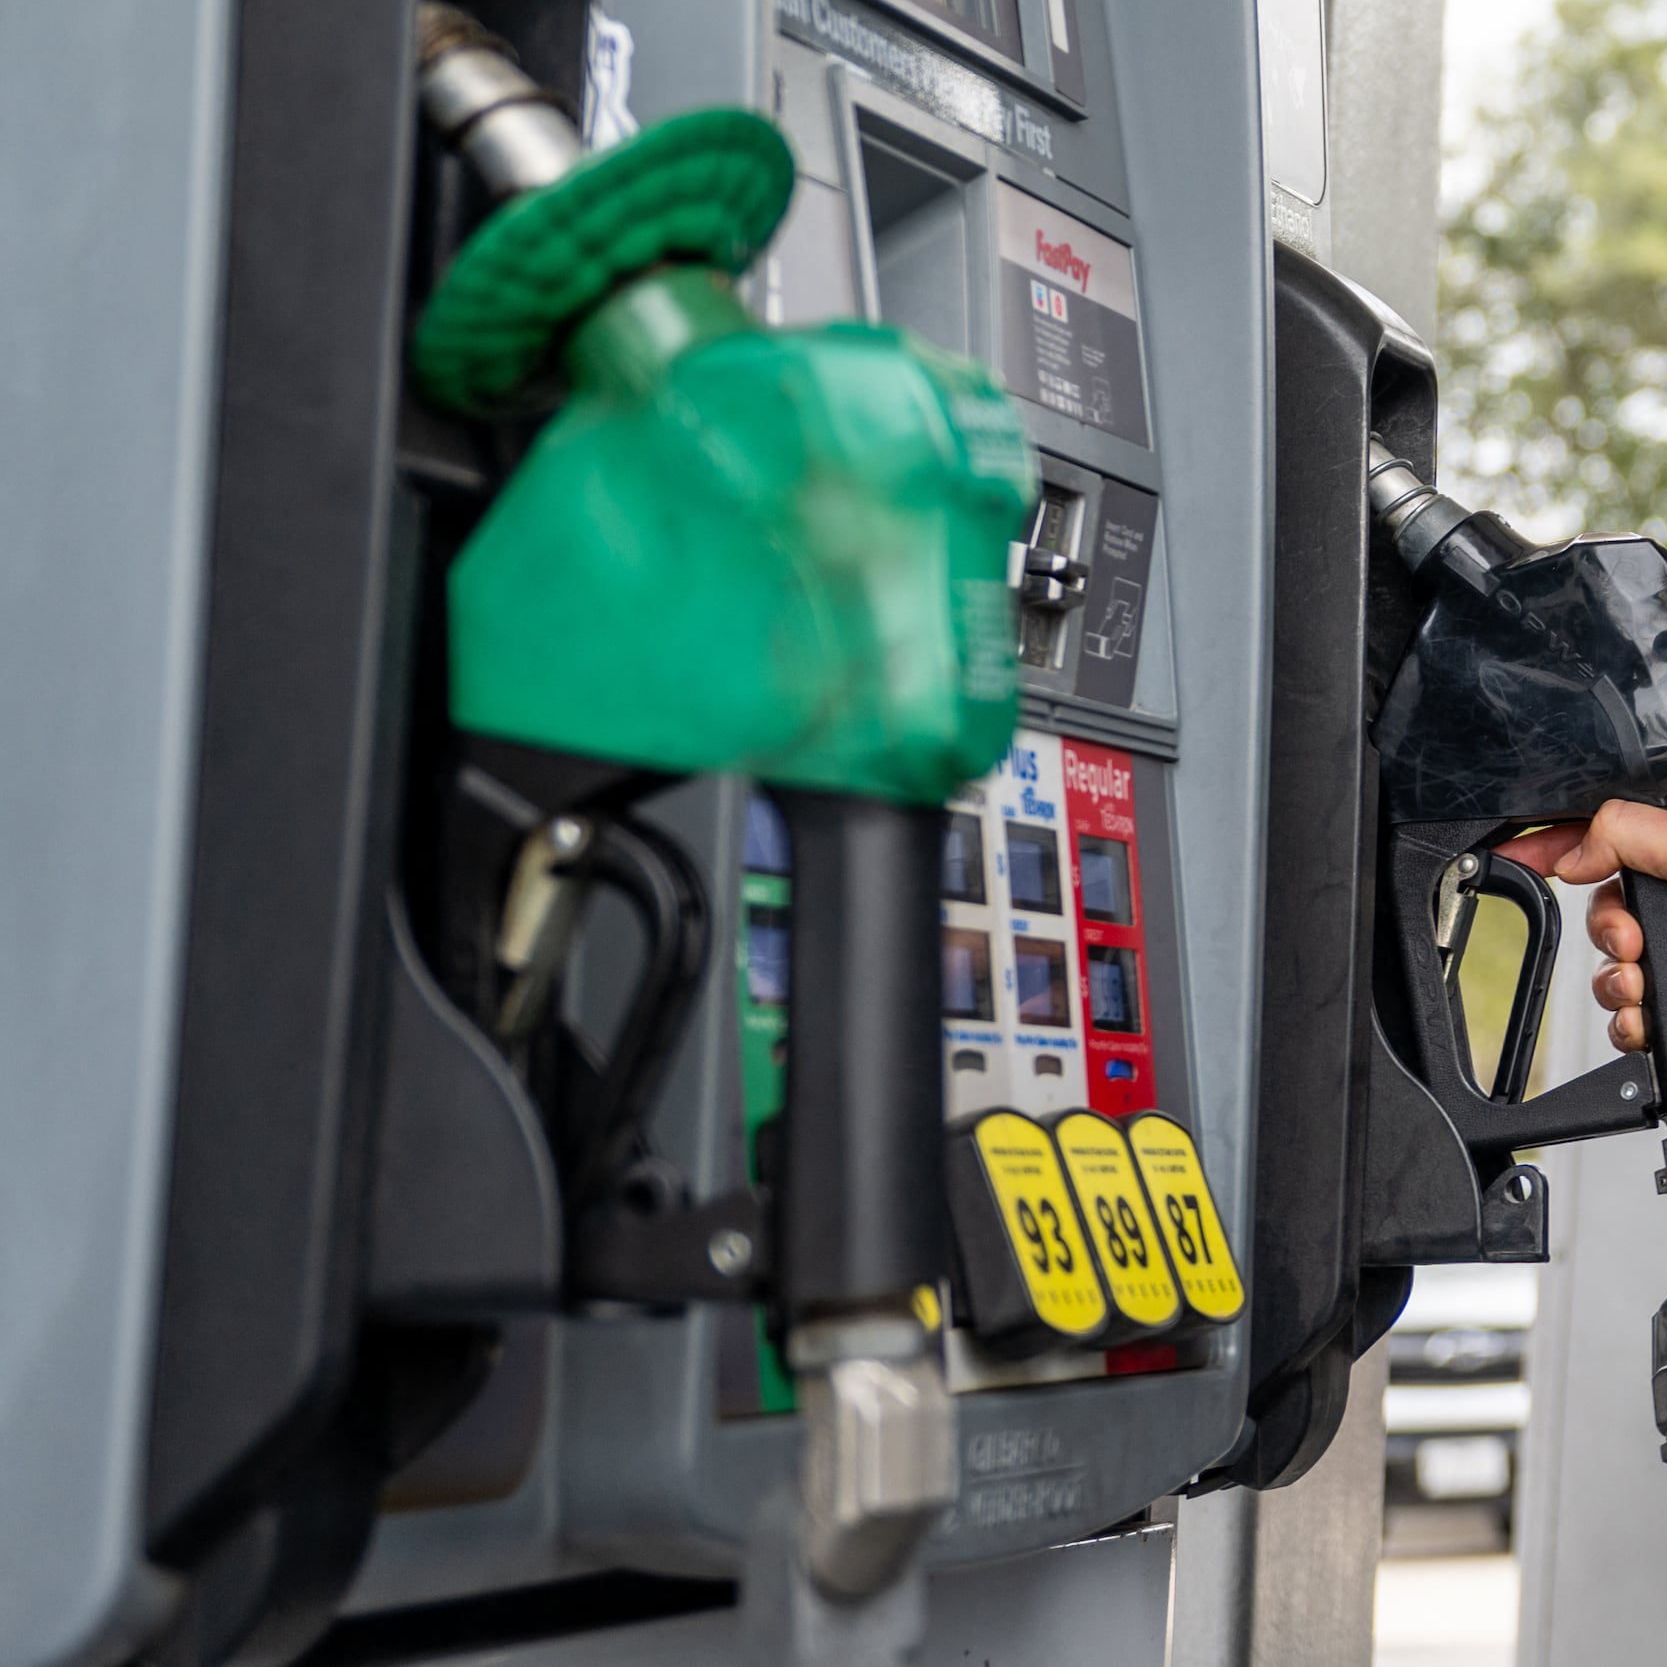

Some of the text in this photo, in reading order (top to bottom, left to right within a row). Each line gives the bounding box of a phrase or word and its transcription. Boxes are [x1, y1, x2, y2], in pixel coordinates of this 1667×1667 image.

[1014, 103, 1053, 160] First
[1035, 228, 1091, 294] FastPay
[1064, 748, 1132, 804] Regular
[1016, 1195, 1074, 1274] 93
[1095, 1194, 1149, 1269] 89
[1165, 1193, 1212, 1265] 87
